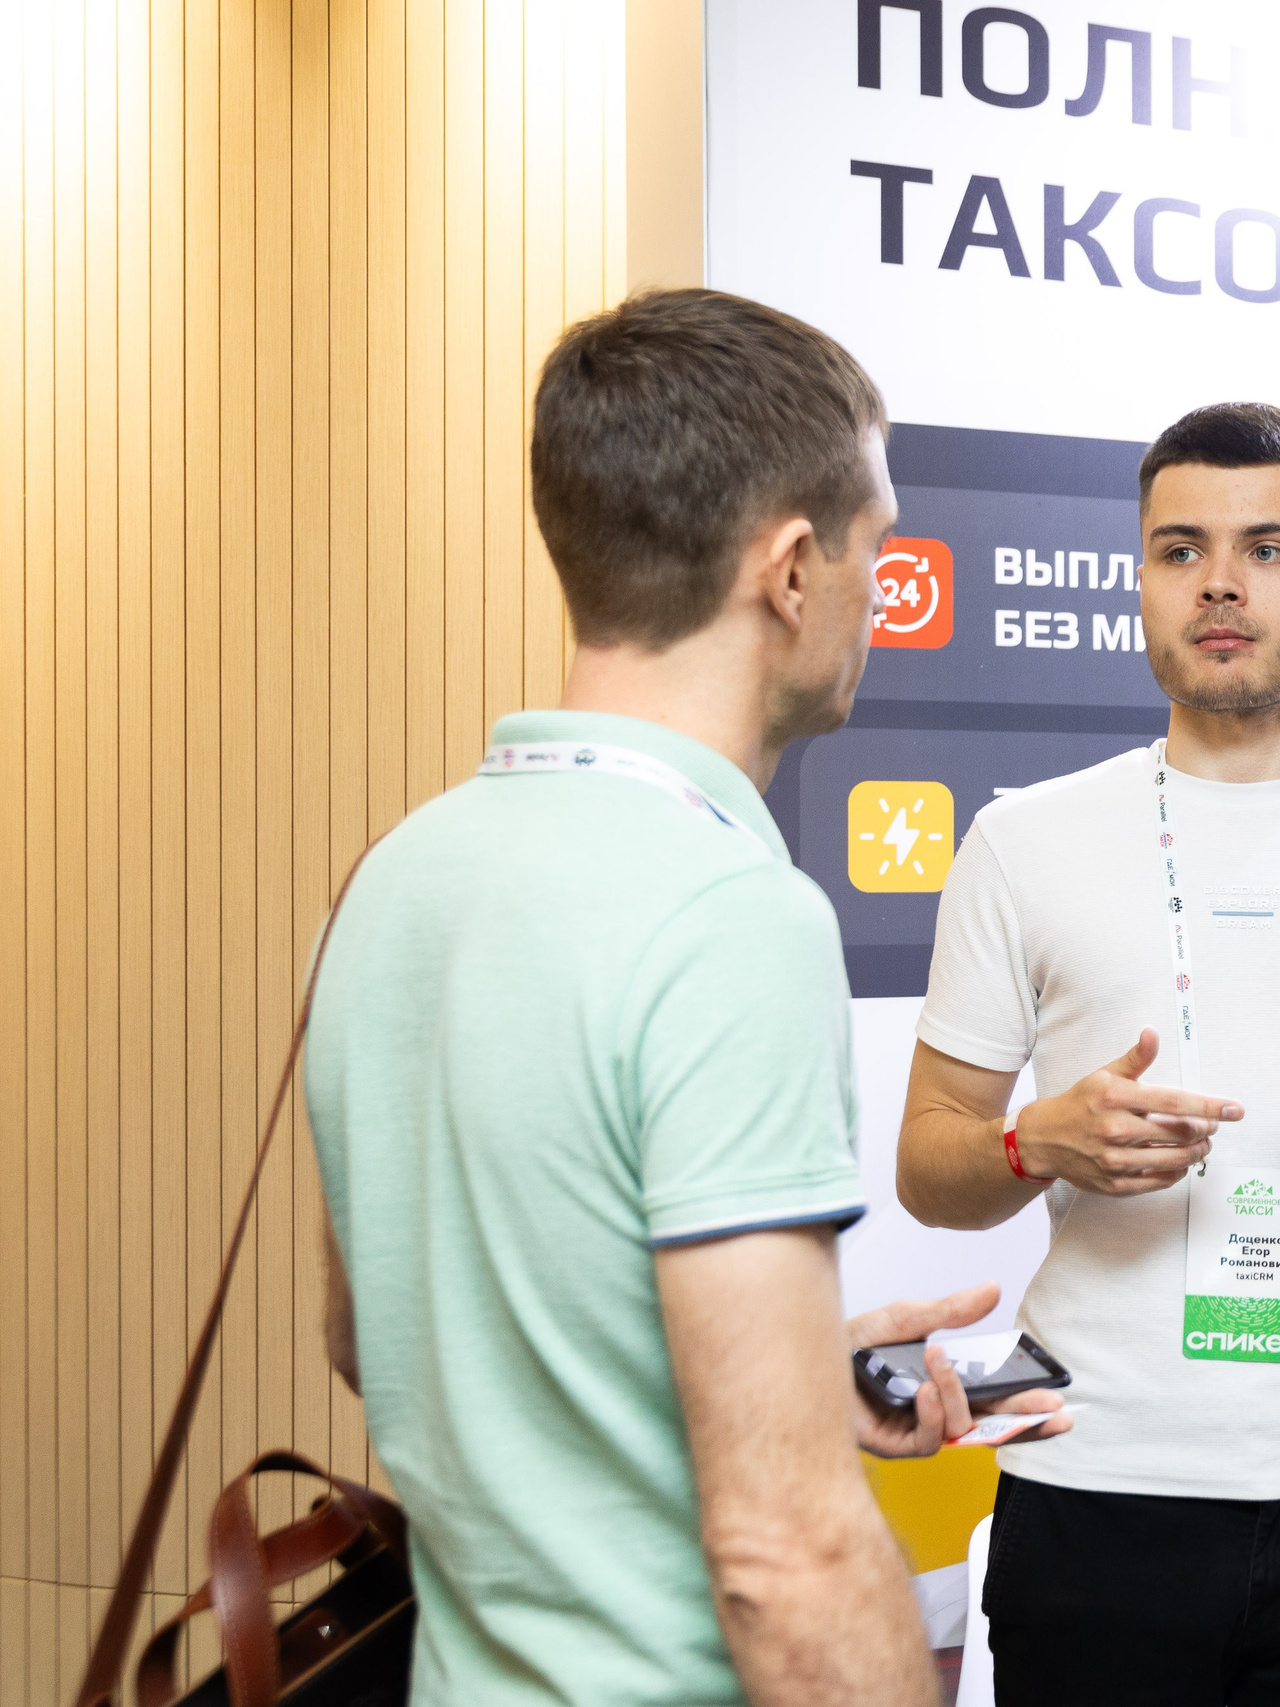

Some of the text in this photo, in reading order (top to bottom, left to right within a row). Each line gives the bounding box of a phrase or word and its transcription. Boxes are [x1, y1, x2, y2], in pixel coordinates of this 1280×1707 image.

[857, 0, 1274, 138] ПОЛН
[995, 547, 1141, 591] ВЫПЛ
[881, 577, 921, 608] 24
[995, 609, 1079, 650] БЕЗ
[1208, 899, 1280, 909] EXPLORE
[1216, 920, 1272, 930] DREAM
[1226, 1196, 1280, 1206] СОВРЕМЕННОЕ
[1234, 1205, 1273, 1216] ТАКСИ
[1242, 1246, 1270, 1258] Егор
[1236, 1272, 1274, 1281] taxiCRM
